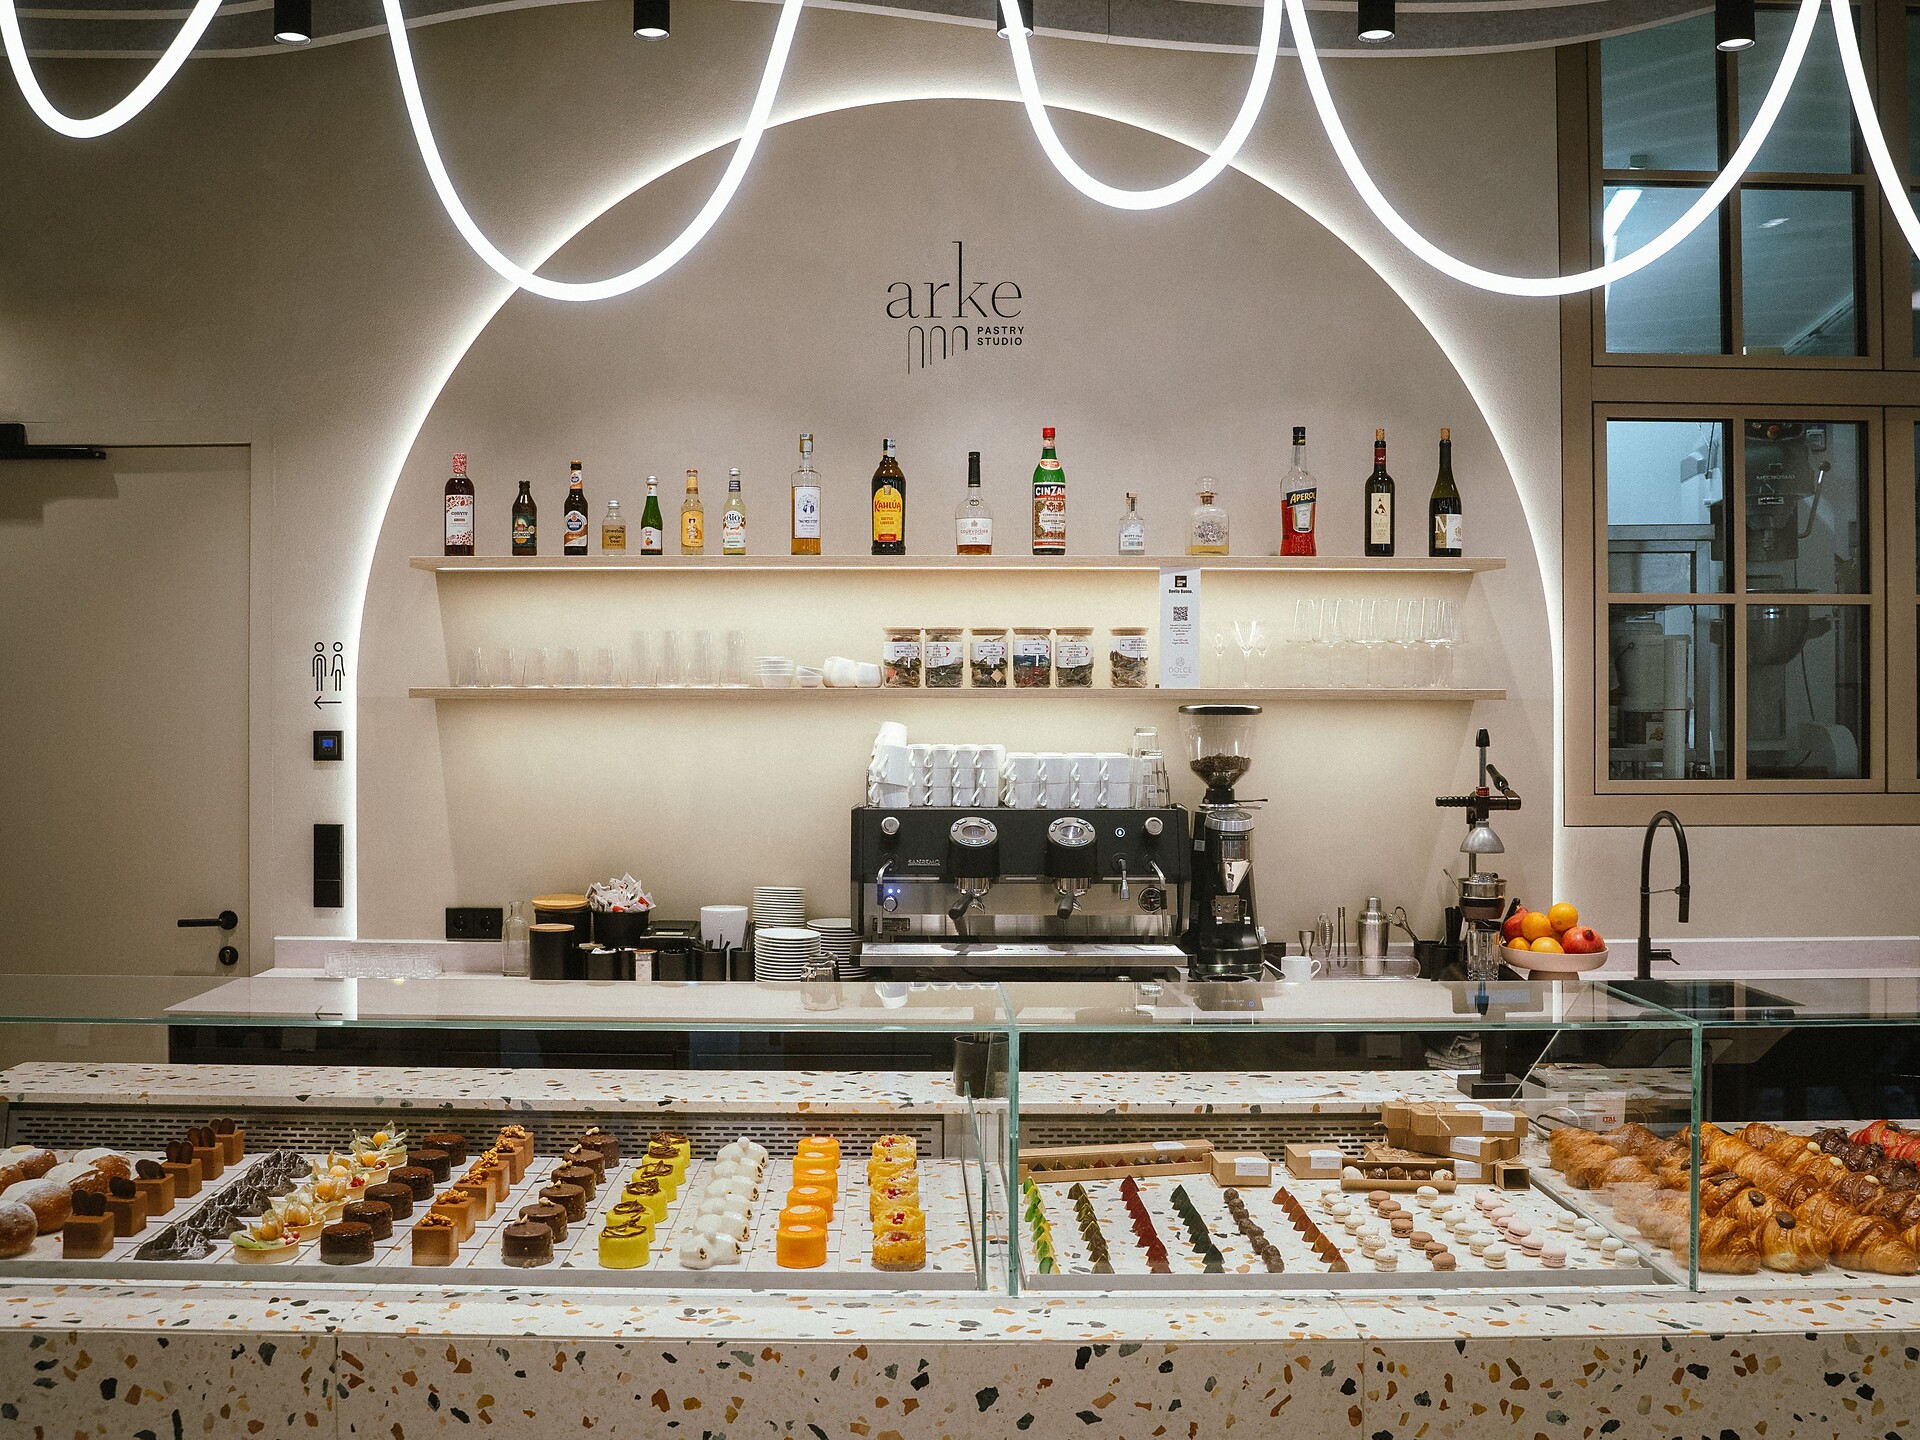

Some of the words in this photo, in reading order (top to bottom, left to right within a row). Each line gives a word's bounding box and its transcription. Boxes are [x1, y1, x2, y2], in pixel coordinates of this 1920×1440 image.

[886, 241, 1023, 319] arke
[977, 326, 1025, 335] PASTRY
[977, 337, 1023, 346] STUDIO
[874, 500, 902, 512] KAHLÚA
